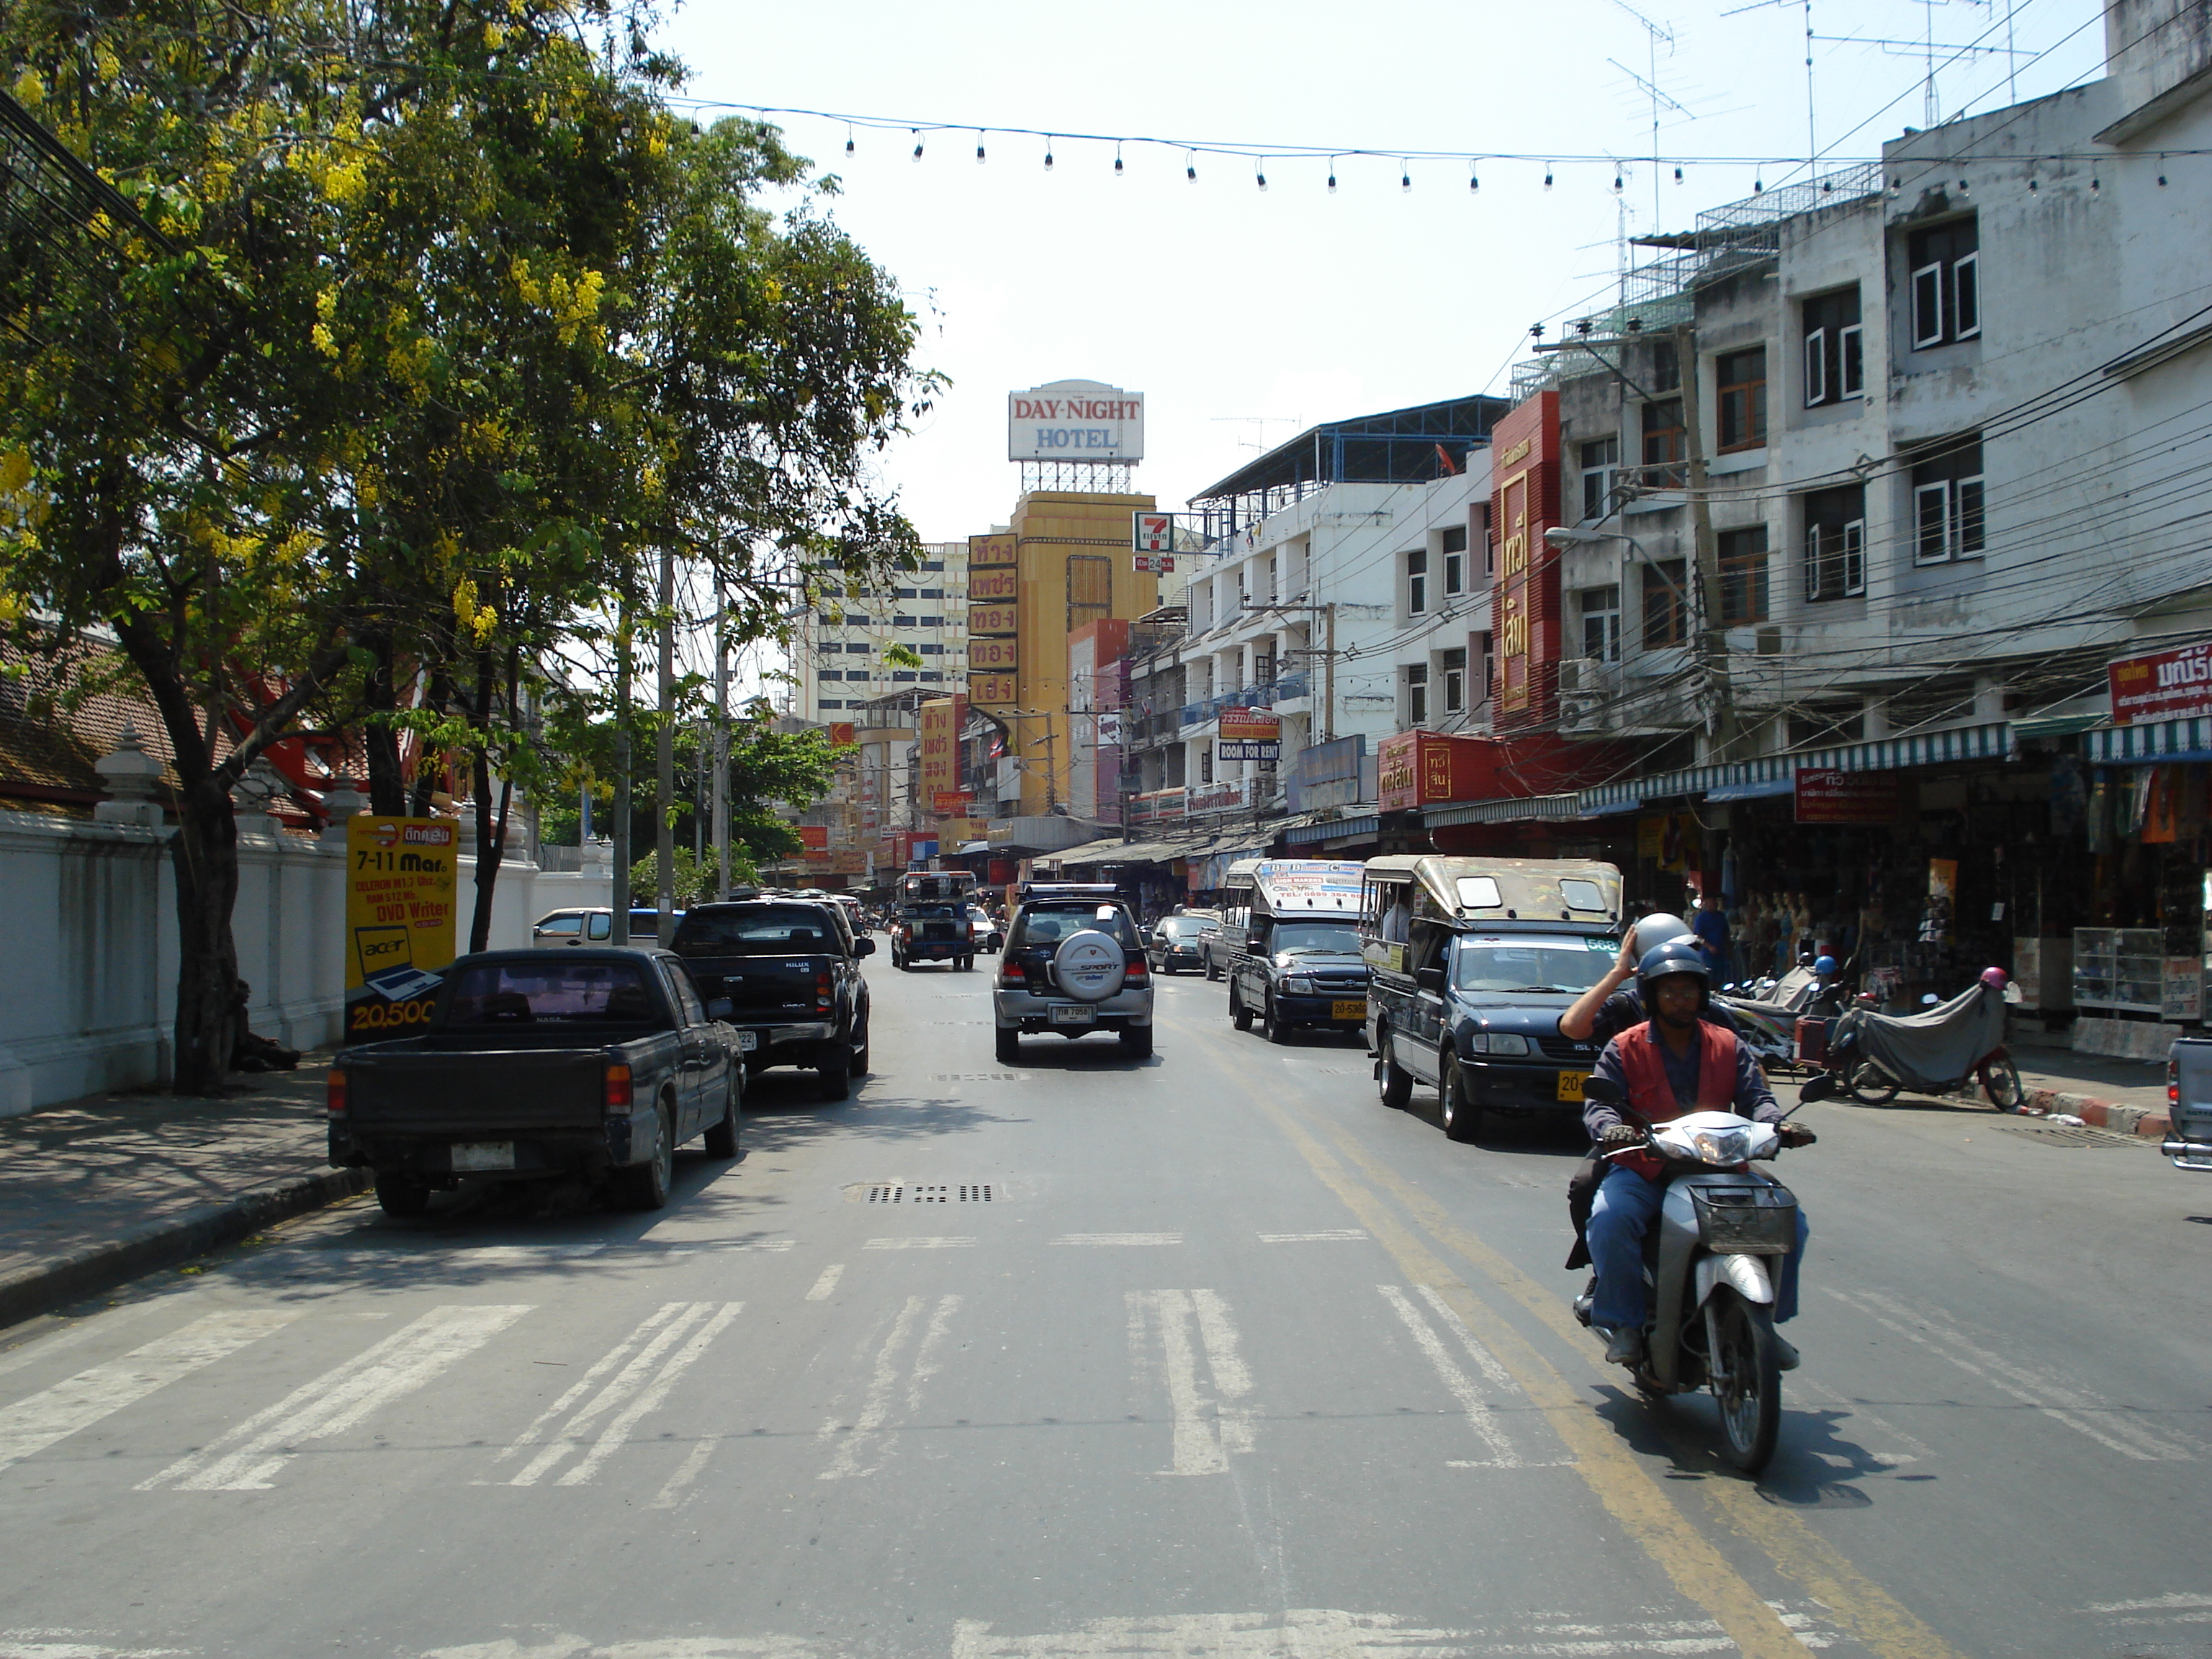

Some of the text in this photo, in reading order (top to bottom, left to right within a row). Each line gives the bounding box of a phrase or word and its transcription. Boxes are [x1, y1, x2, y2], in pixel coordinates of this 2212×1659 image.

[1015, 399, 1140, 420] DAY-NIGHT
[1037, 428, 1118, 449] HOTEL
[1144, 518, 1166, 549] 7
[974, 537, 1012, 562] ห้าง
[1149, 559, 1161, 568] 24
[972, 573, 1015, 595] เพชร
[973, 610, 1014, 629] ทอง
[973, 644, 1014, 662] ทอง
[2157, 645, 2212, 687] มณีรั
[925, 734, 947, 754] เพชร
[1221, 745, 1277, 758] ROOM FOR RENT
[357, 850, 393, 871] 7-11
[356, 879, 391, 891] CELERON
[367, 894, 383, 903] RAM
[377, 901, 449, 922] DVD Writer
[366, 940, 404, 956] acer
[1588, 940, 1617, 950] 568
